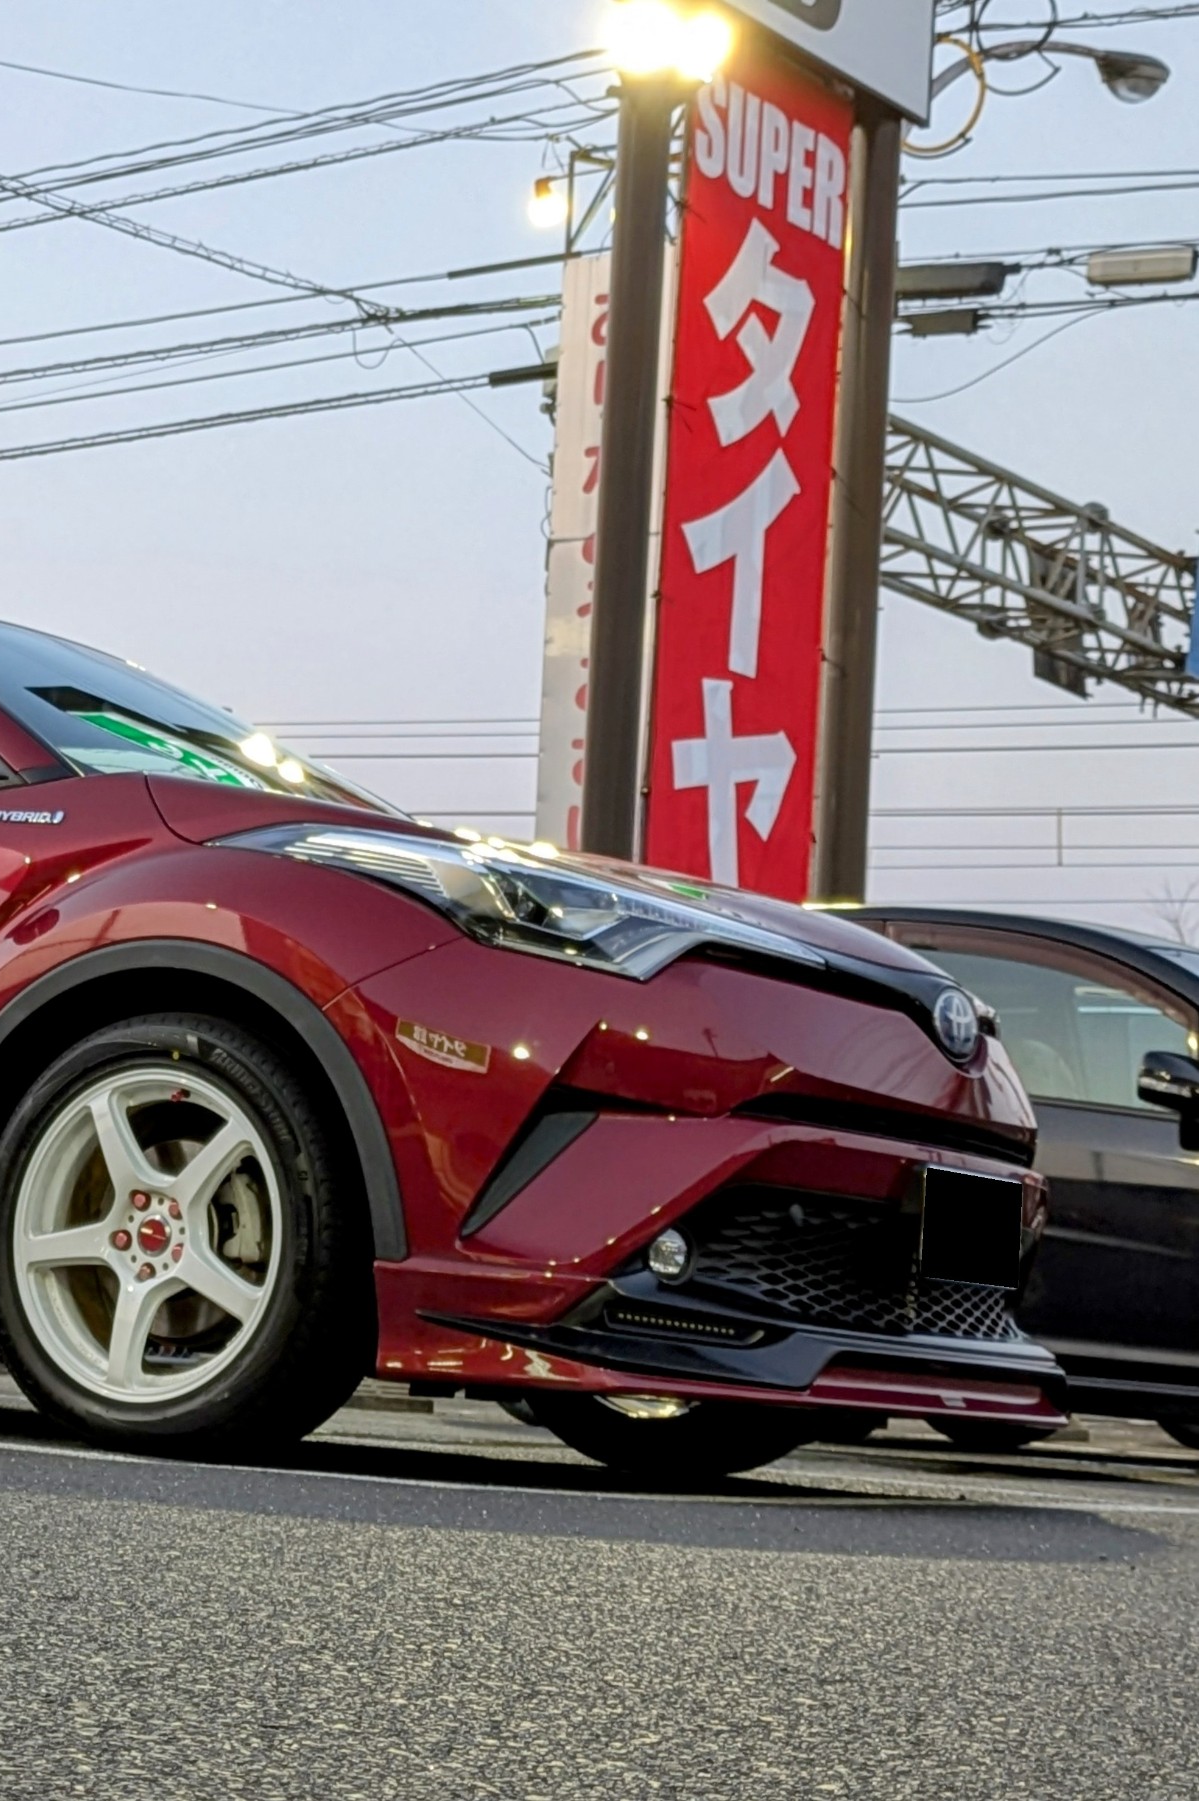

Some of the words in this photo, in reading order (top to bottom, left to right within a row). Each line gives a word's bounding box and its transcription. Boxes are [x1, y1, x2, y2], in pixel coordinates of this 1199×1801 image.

[695, 73, 846, 250] SUPER
[672, 218, 815, 888] タイヤ
